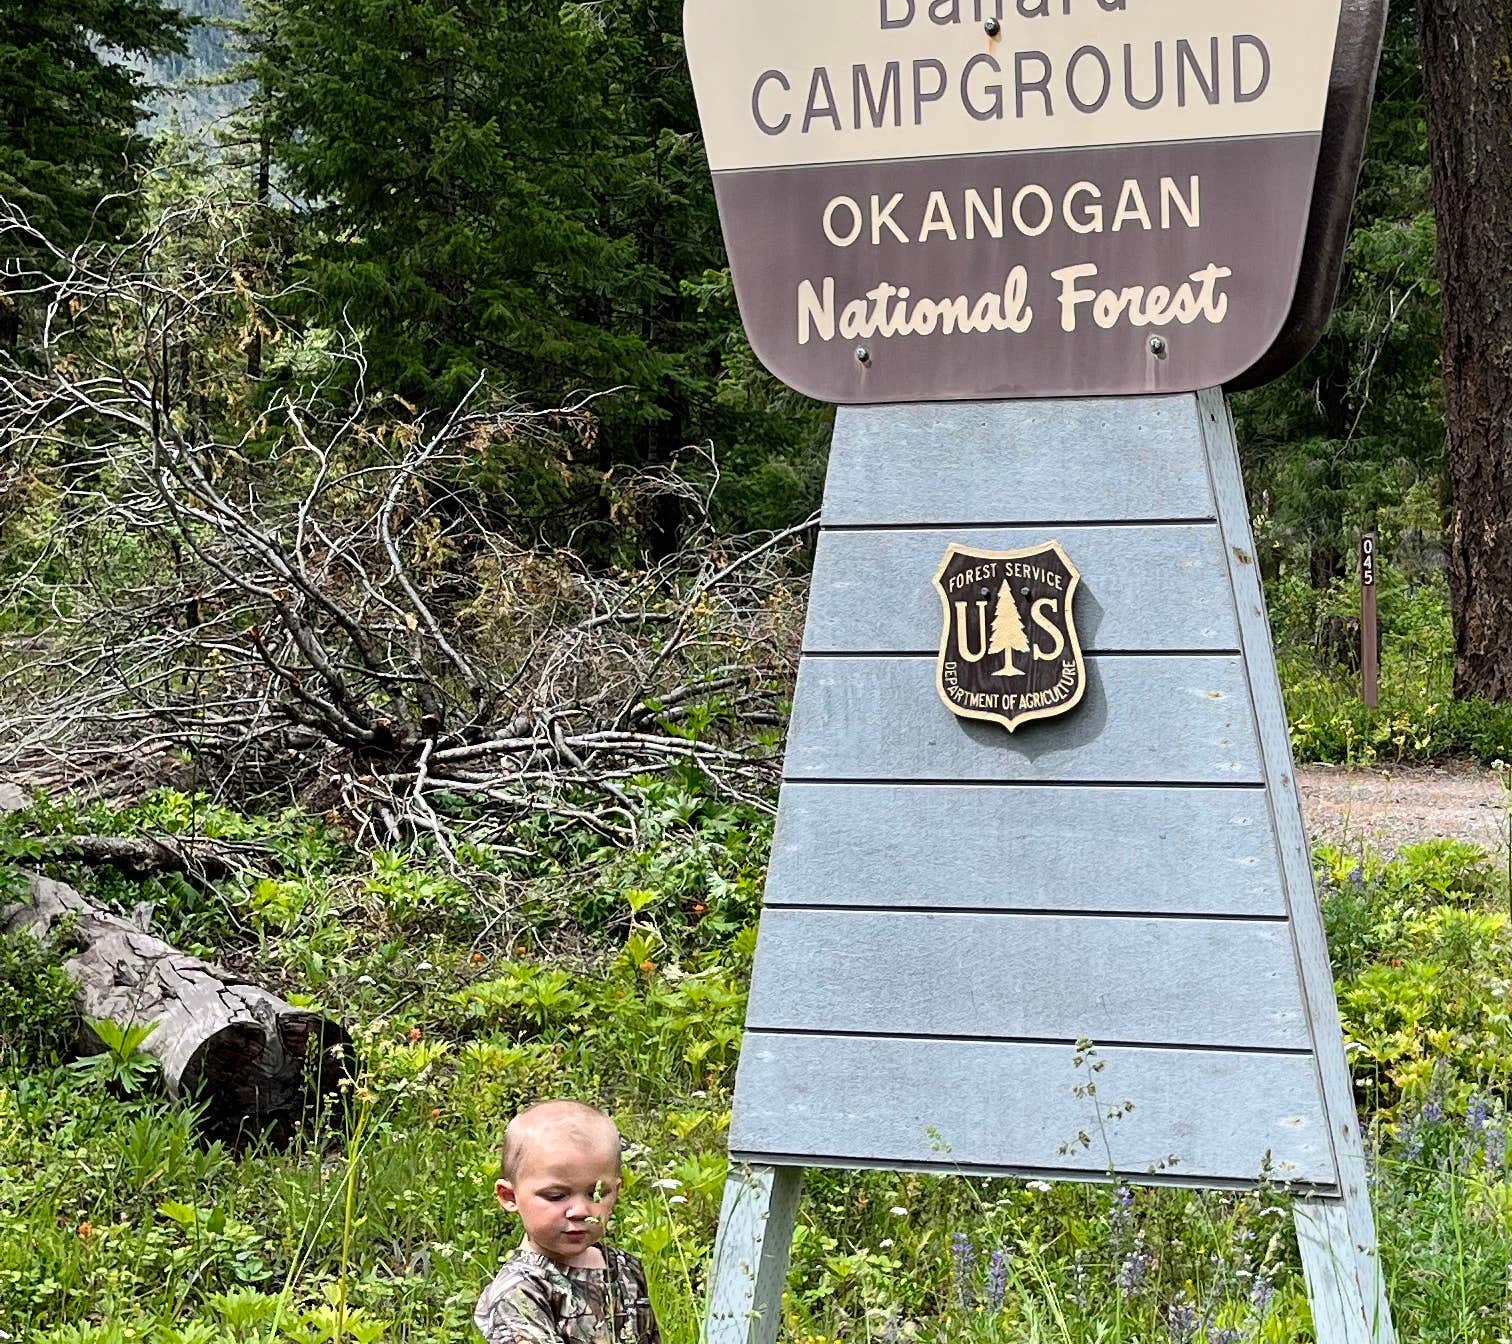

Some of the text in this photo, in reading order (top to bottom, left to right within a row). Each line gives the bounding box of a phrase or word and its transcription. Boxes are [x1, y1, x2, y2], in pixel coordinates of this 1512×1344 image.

[751, 33, 1272, 136] CAMPGROUND
[821, 174, 1201, 248] OKANOGAN
[797, 262, 1233, 345] National Forest
[949, 562, 1064, 593] FOREST SERVICE
[1363, 539, 1373, 586] 045
[944, 659, 1077, 710] DEPARTMENT OF AGRICULTURE
